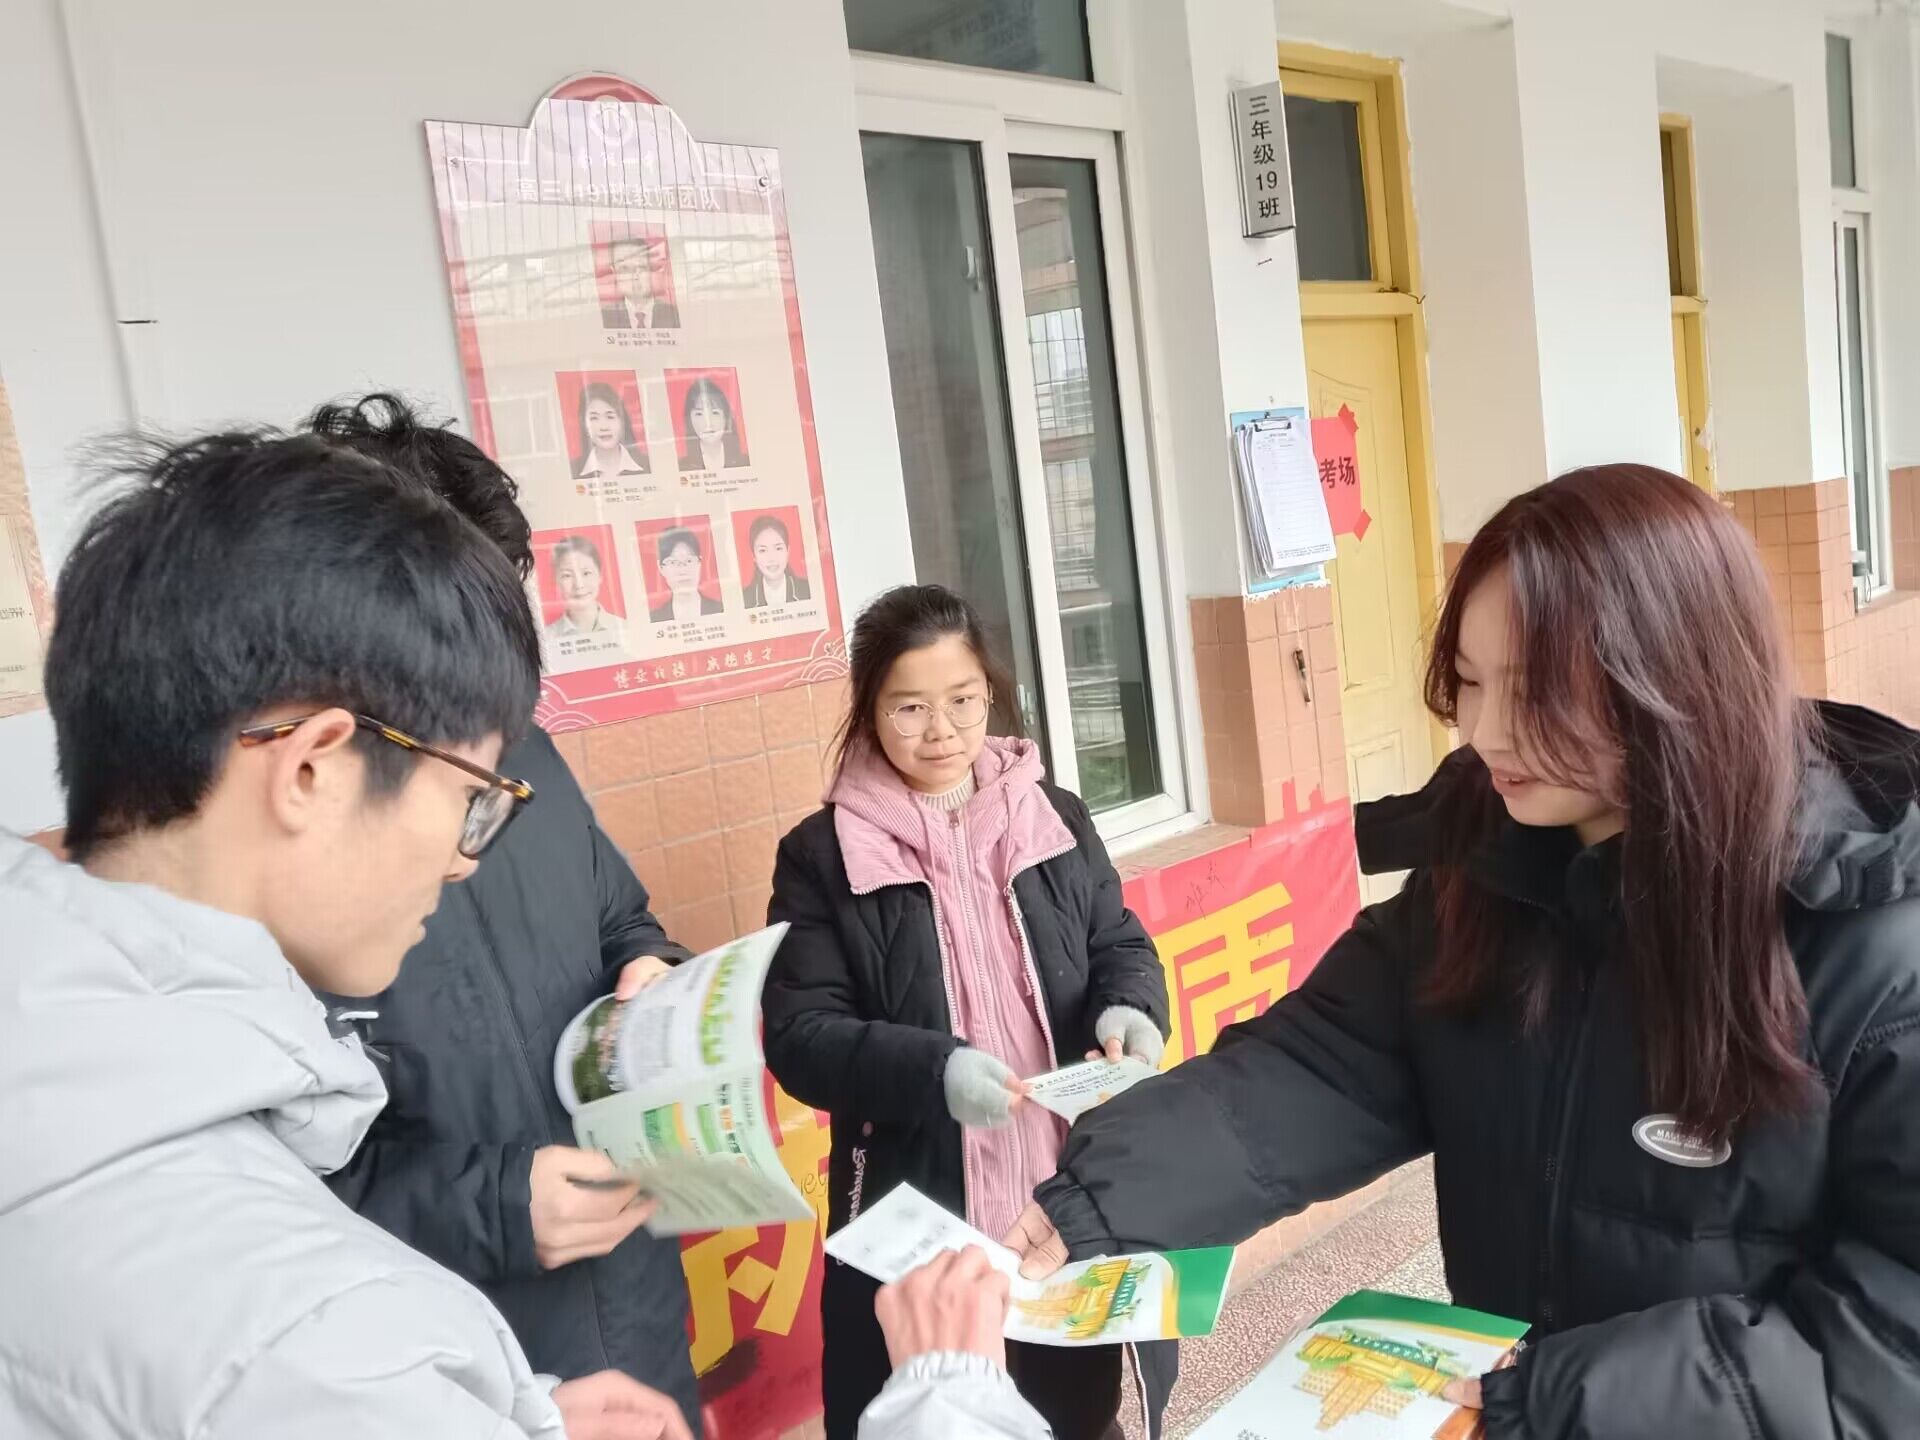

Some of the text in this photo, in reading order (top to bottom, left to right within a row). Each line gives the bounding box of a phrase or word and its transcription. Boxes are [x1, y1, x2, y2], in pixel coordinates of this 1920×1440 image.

[1249, 95, 1281, 219] 三年级19班
[1319, 456, 1356, 489] 考场
